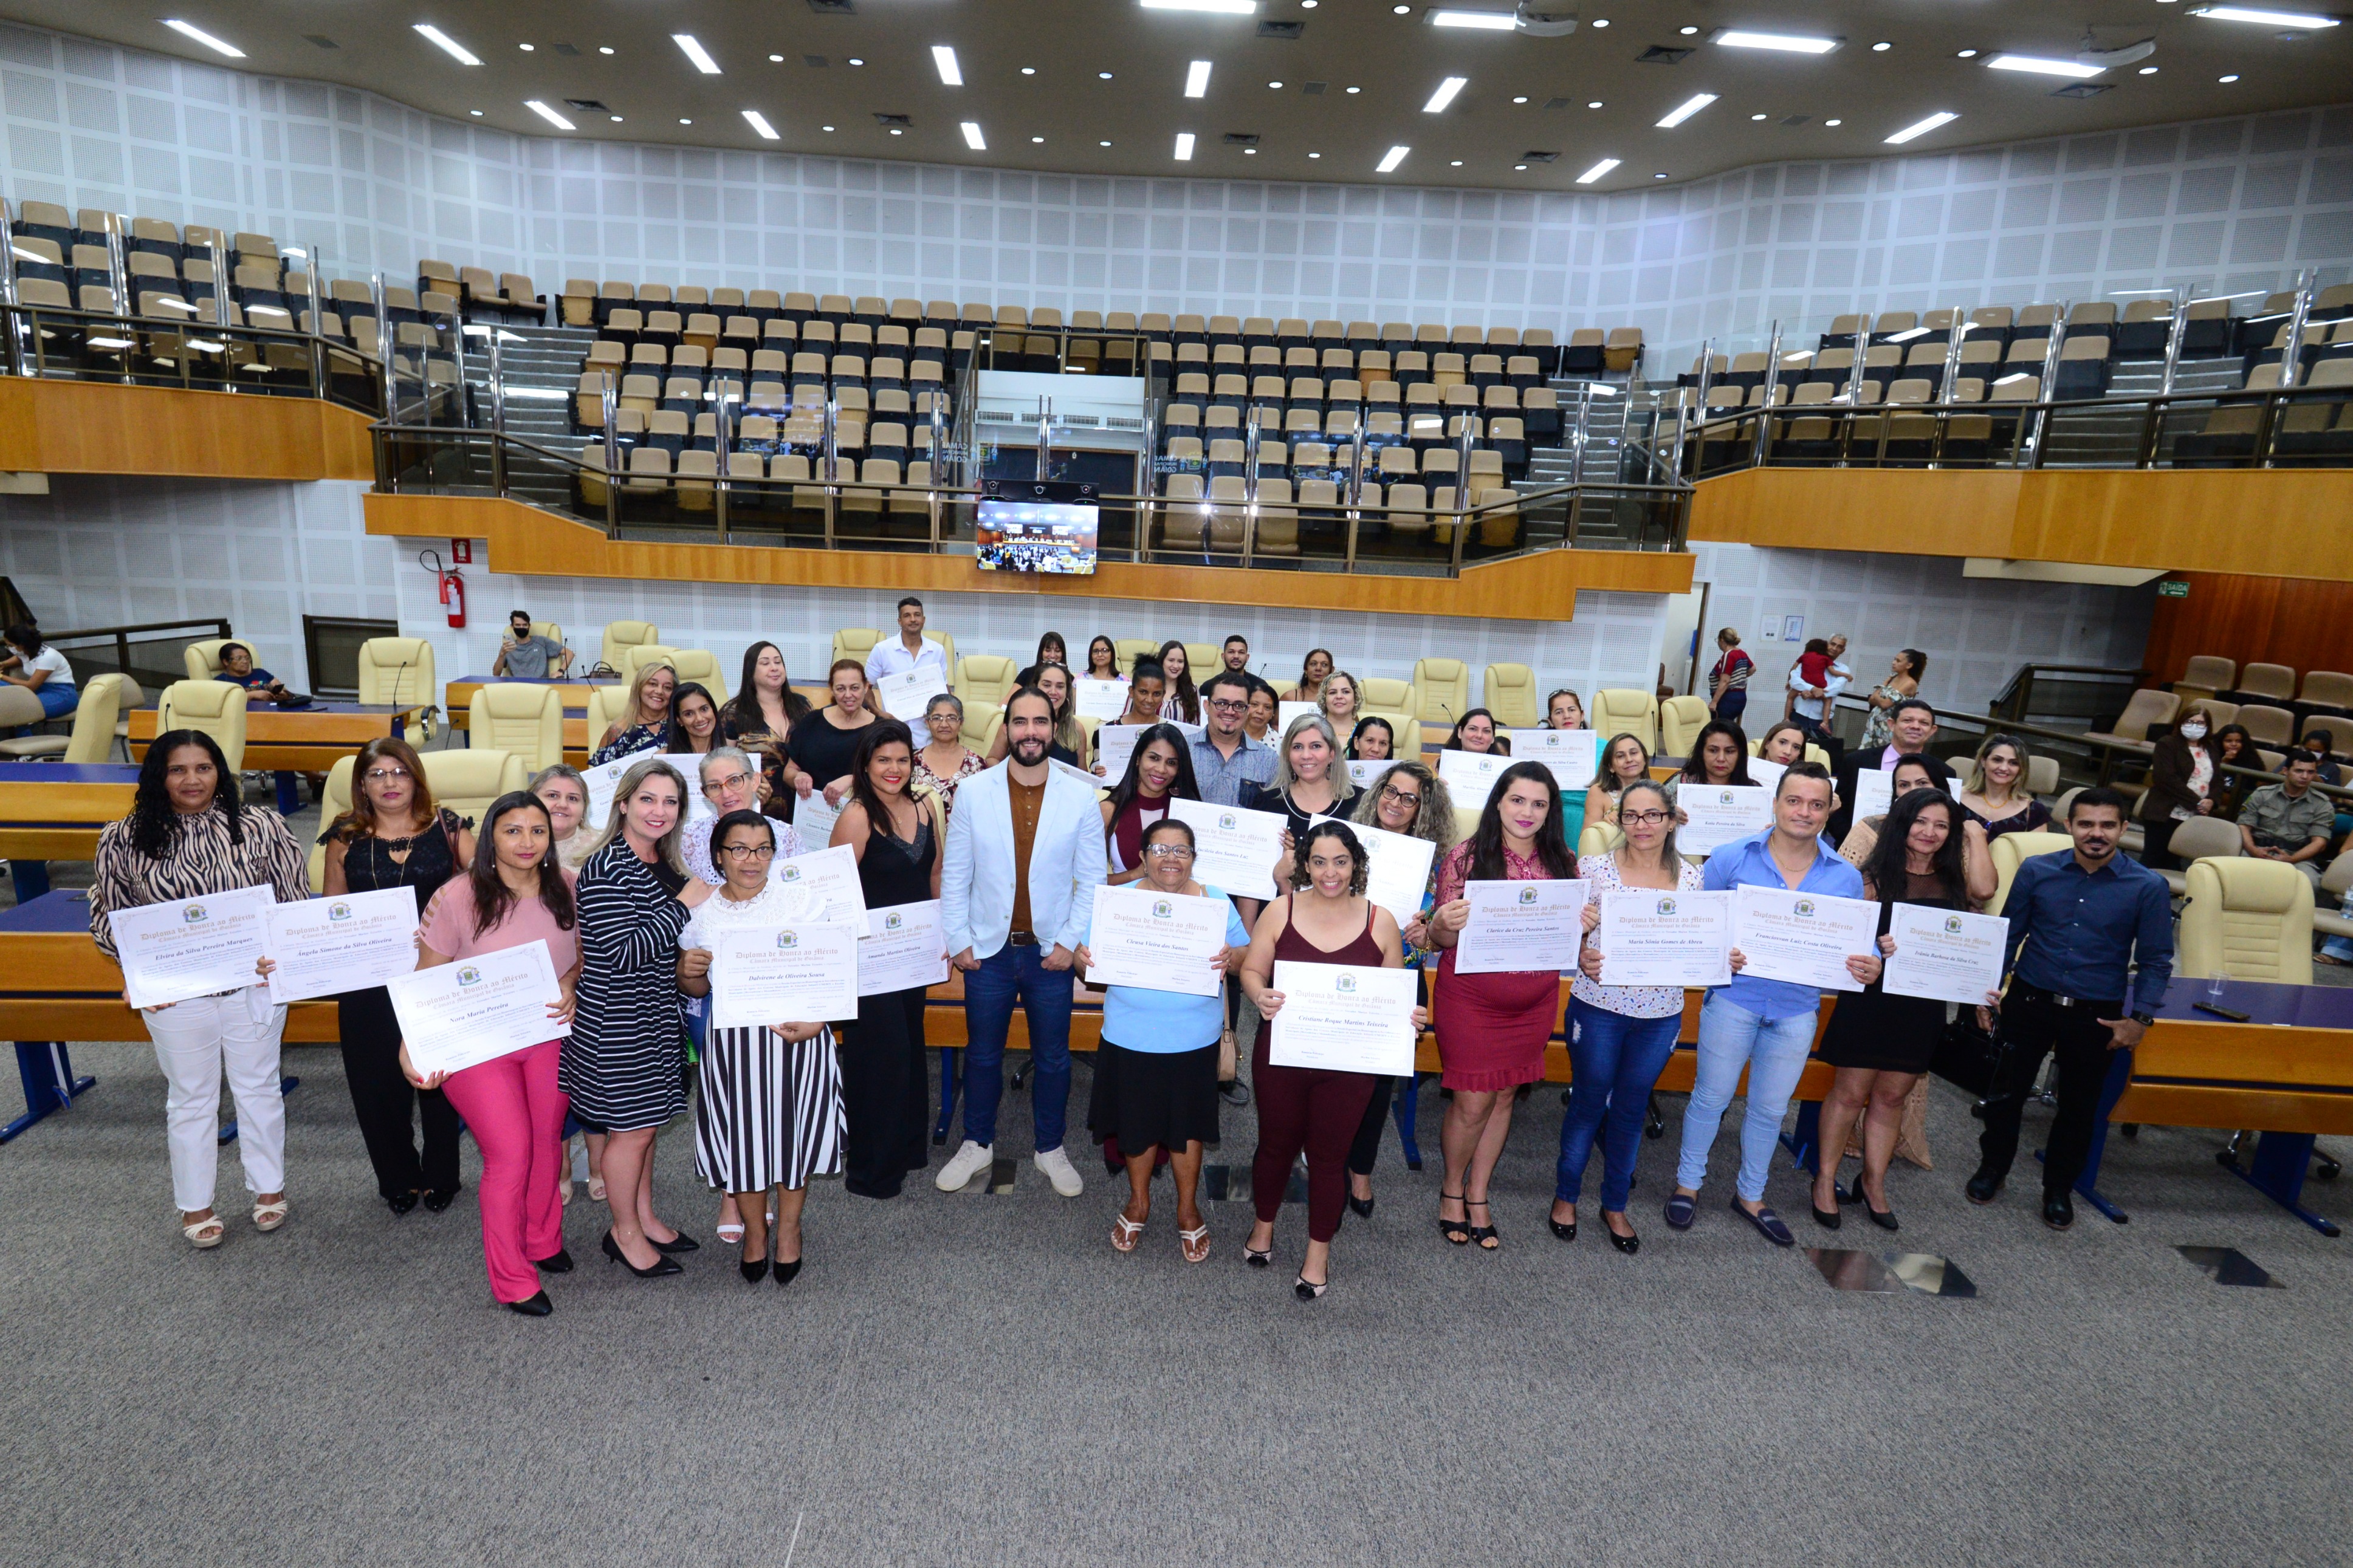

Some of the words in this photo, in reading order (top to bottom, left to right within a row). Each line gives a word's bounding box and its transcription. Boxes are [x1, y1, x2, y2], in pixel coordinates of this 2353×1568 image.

[1218, 829, 1237, 838] Honra
[1247, 834, 1268, 842] Mérito
[817, 874, 840, 883] Mérito
[140, 930, 176, 940] Diploma
[188, 922, 215, 931] Honra
[228, 914, 255, 923] Mérito
[1113, 913, 1141, 923] Diploma
[1153, 919, 1174, 927] Honra
[1184, 923, 1208, 931] Mérito
[1753, 910, 1782, 920] Diploma
[1794, 916, 1816, 925] Honra
[1828, 922, 1853, 931] Mérito
[286, 926, 319, 936] Diploma
[1755, 933, 1788, 942] Franciosvan
[415, 994, 450, 1008] Diploma
[462, 984, 489, 995] Honra
[502, 973, 528, 984] Mérito
[1295, 990, 1325, 999] Diploma
[1337, 993, 1359, 1002] Honra
[1372, 996, 1396, 1004] Mérito
[487, 1003, 509, 1012] Pereira
